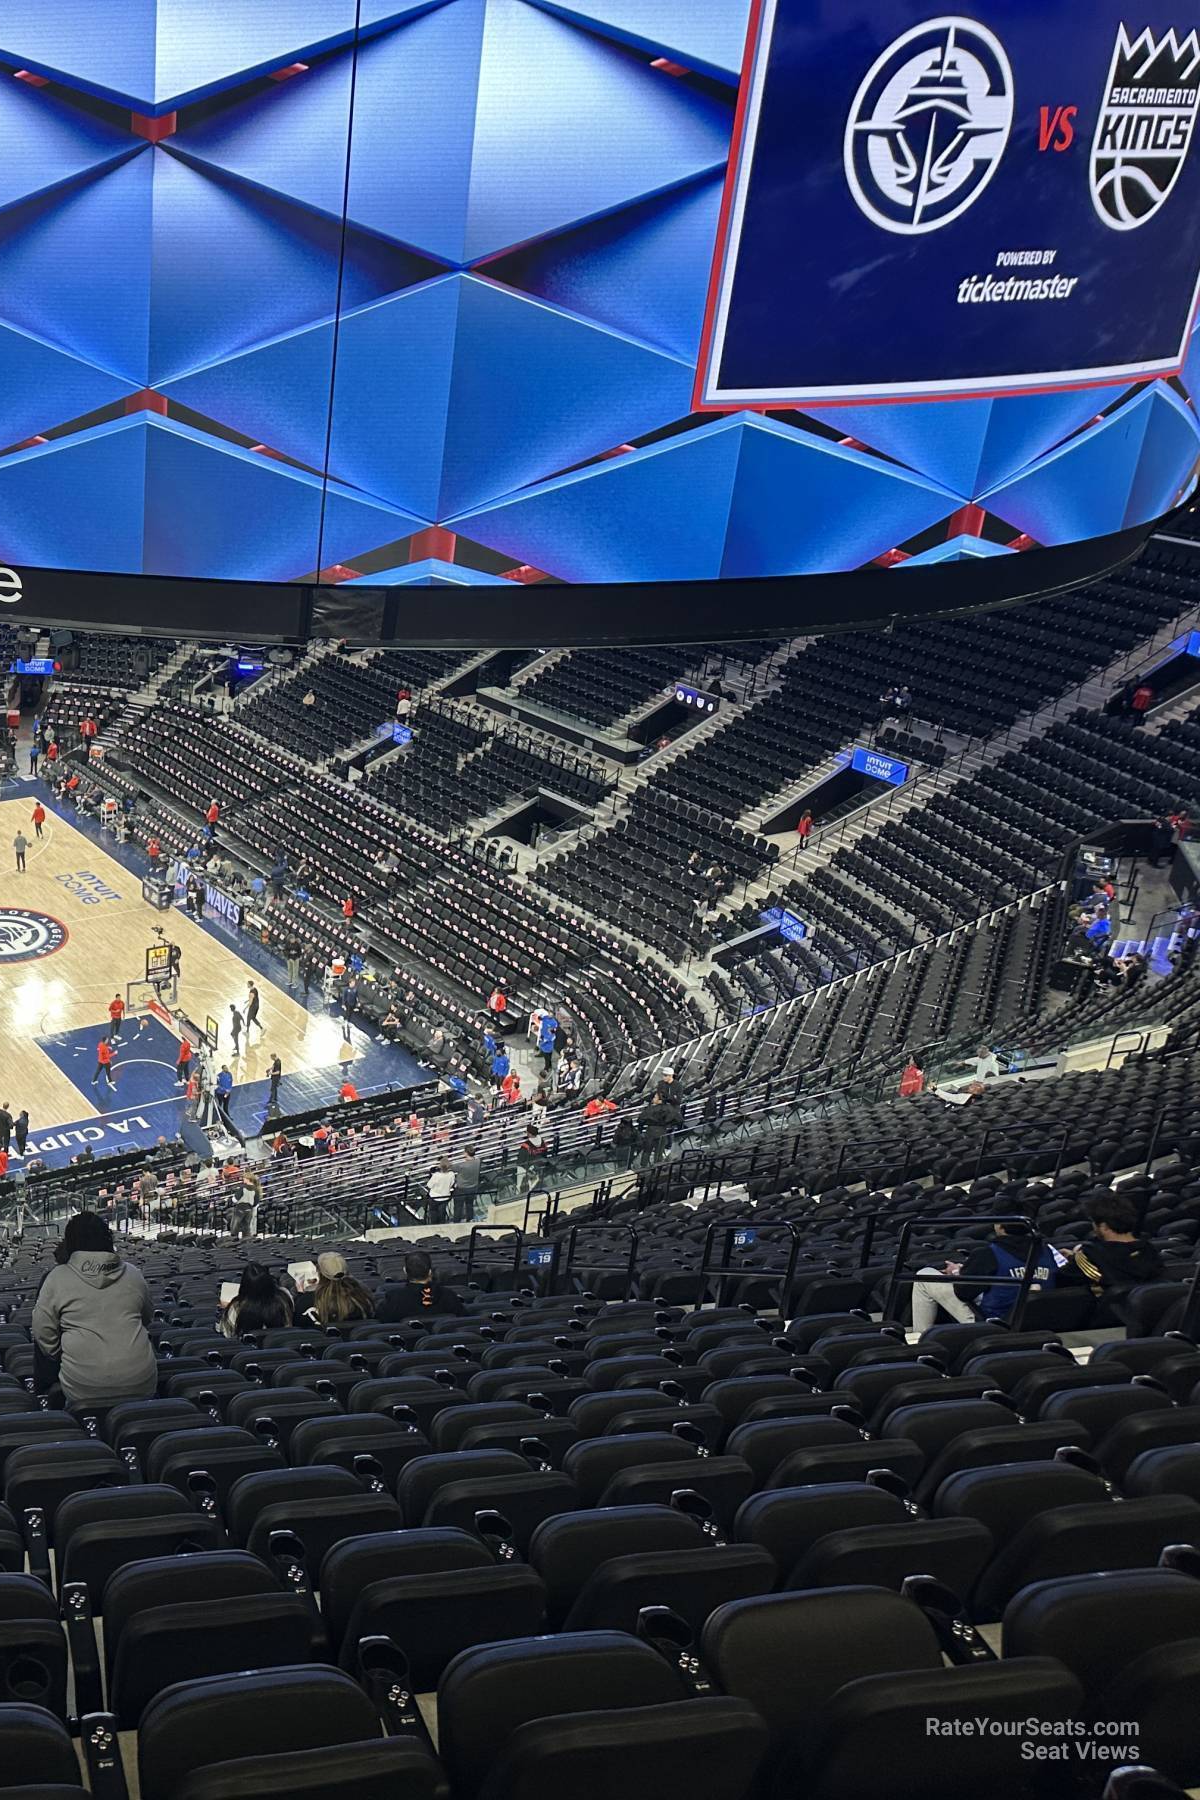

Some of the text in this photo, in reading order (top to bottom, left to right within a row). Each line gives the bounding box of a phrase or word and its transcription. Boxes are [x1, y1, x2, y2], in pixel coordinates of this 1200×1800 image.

[1110, 86, 1197, 105] SACRAMENTO
[1037, 105, 1078, 152] VS
[1098, 113, 1193, 151] KINGS
[996, 250, 1056, 267] POWERED BY
[957, 274, 1078, 304] ticketmaster
[205, 884, 240, 924] WAVES
[37, 917, 62, 955] ANGELES
[106, 1116, 151, 1133] LA
[734, 1236, 746, 1245] 19
[539, 1254, 551, 1264] 19
[1009, 1266, 1050, 1280] LEOARD
